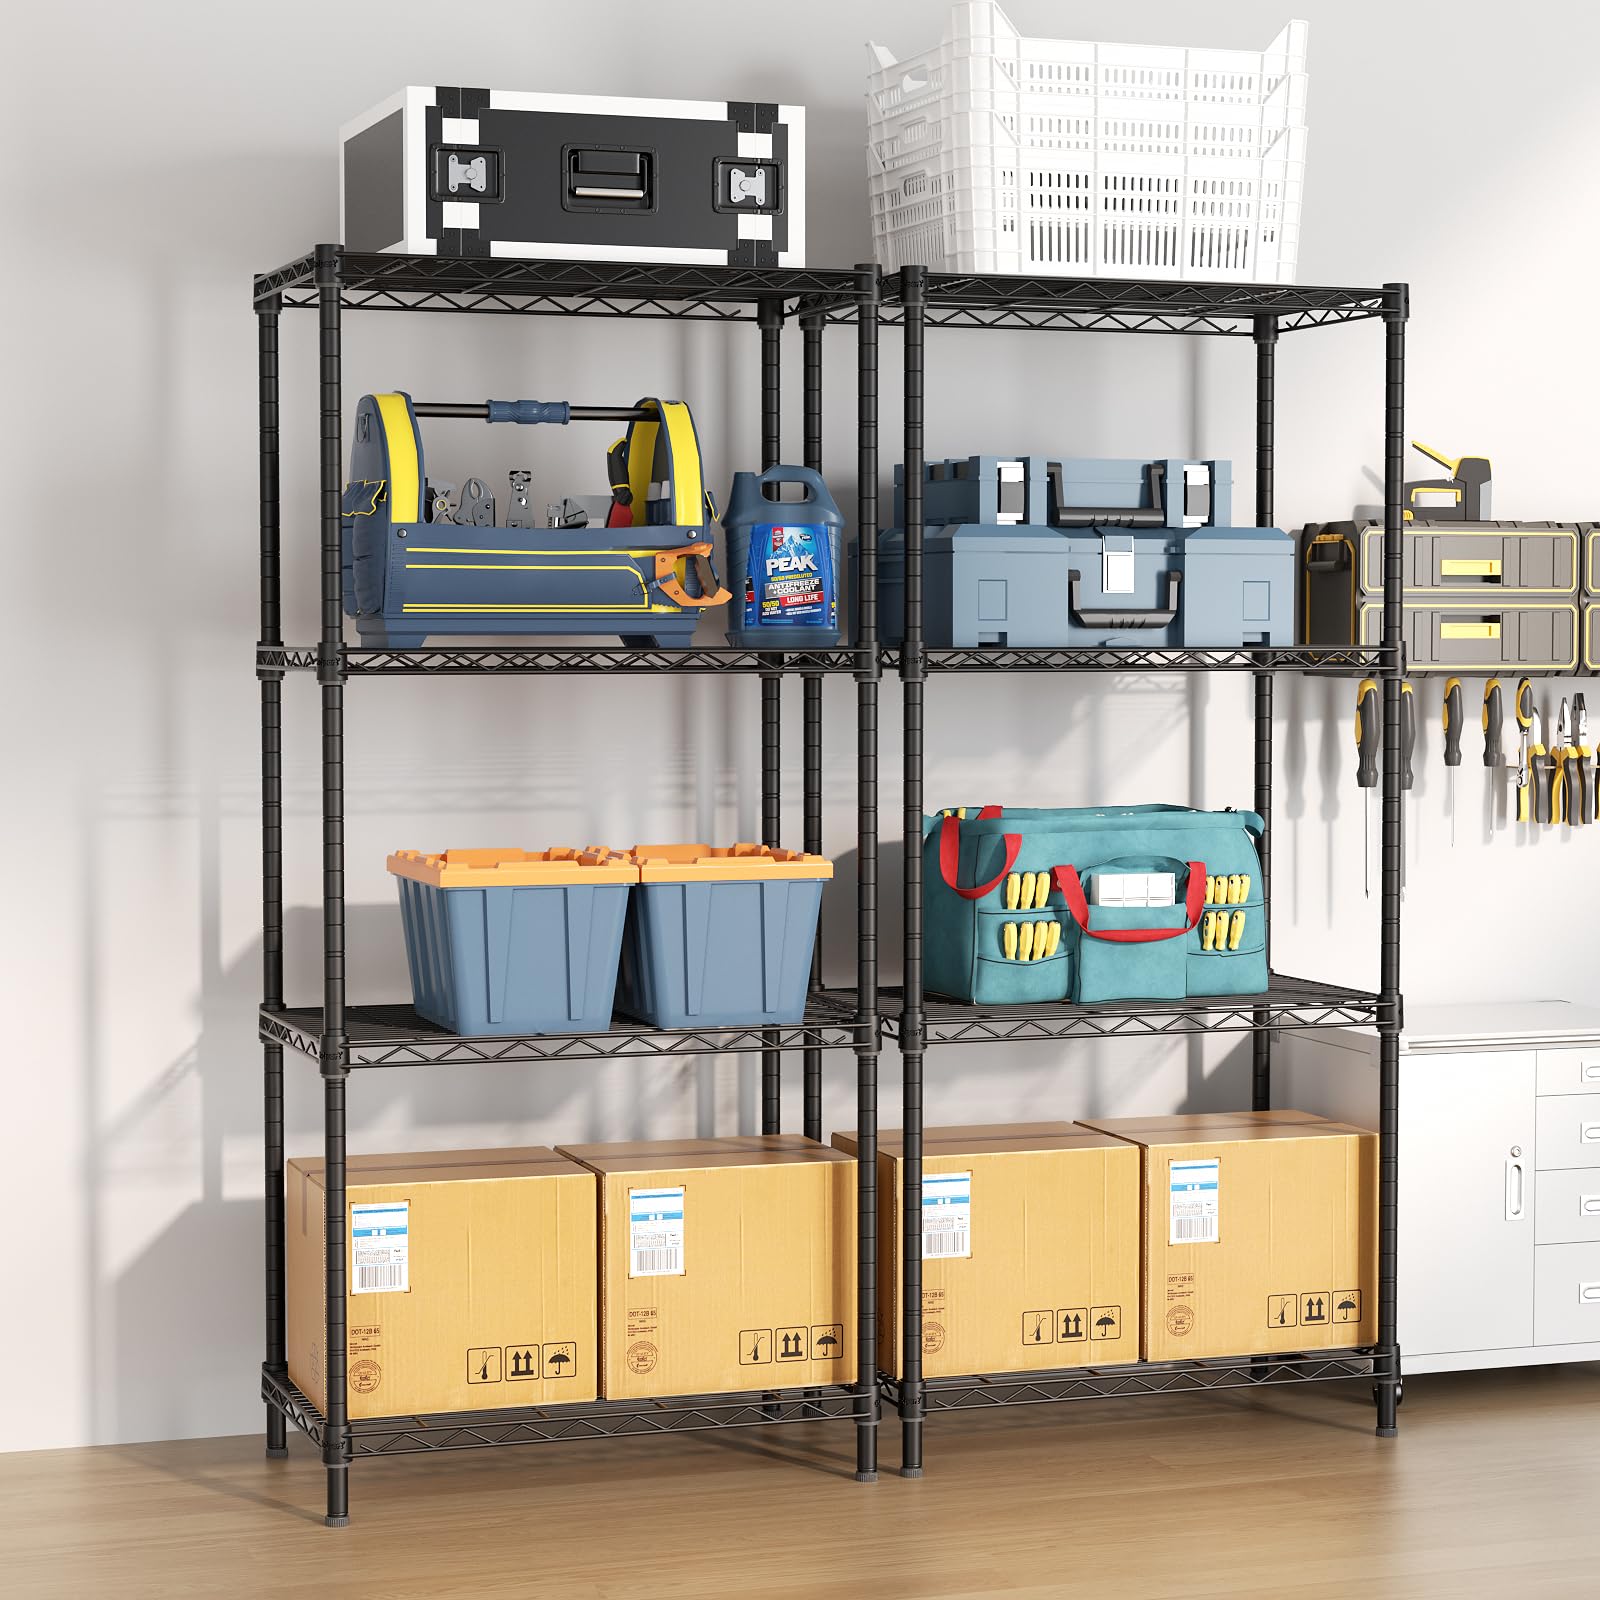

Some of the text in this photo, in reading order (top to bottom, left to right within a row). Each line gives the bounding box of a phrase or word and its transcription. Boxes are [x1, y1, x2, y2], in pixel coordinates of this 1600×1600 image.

[766, 554, 818, 576] PEAK
[768, 578, 820, 590] ANTIFREEZE
[786, 593, 819, 603] LONG LIFE
[762, 600, 780, 608] 50/50
